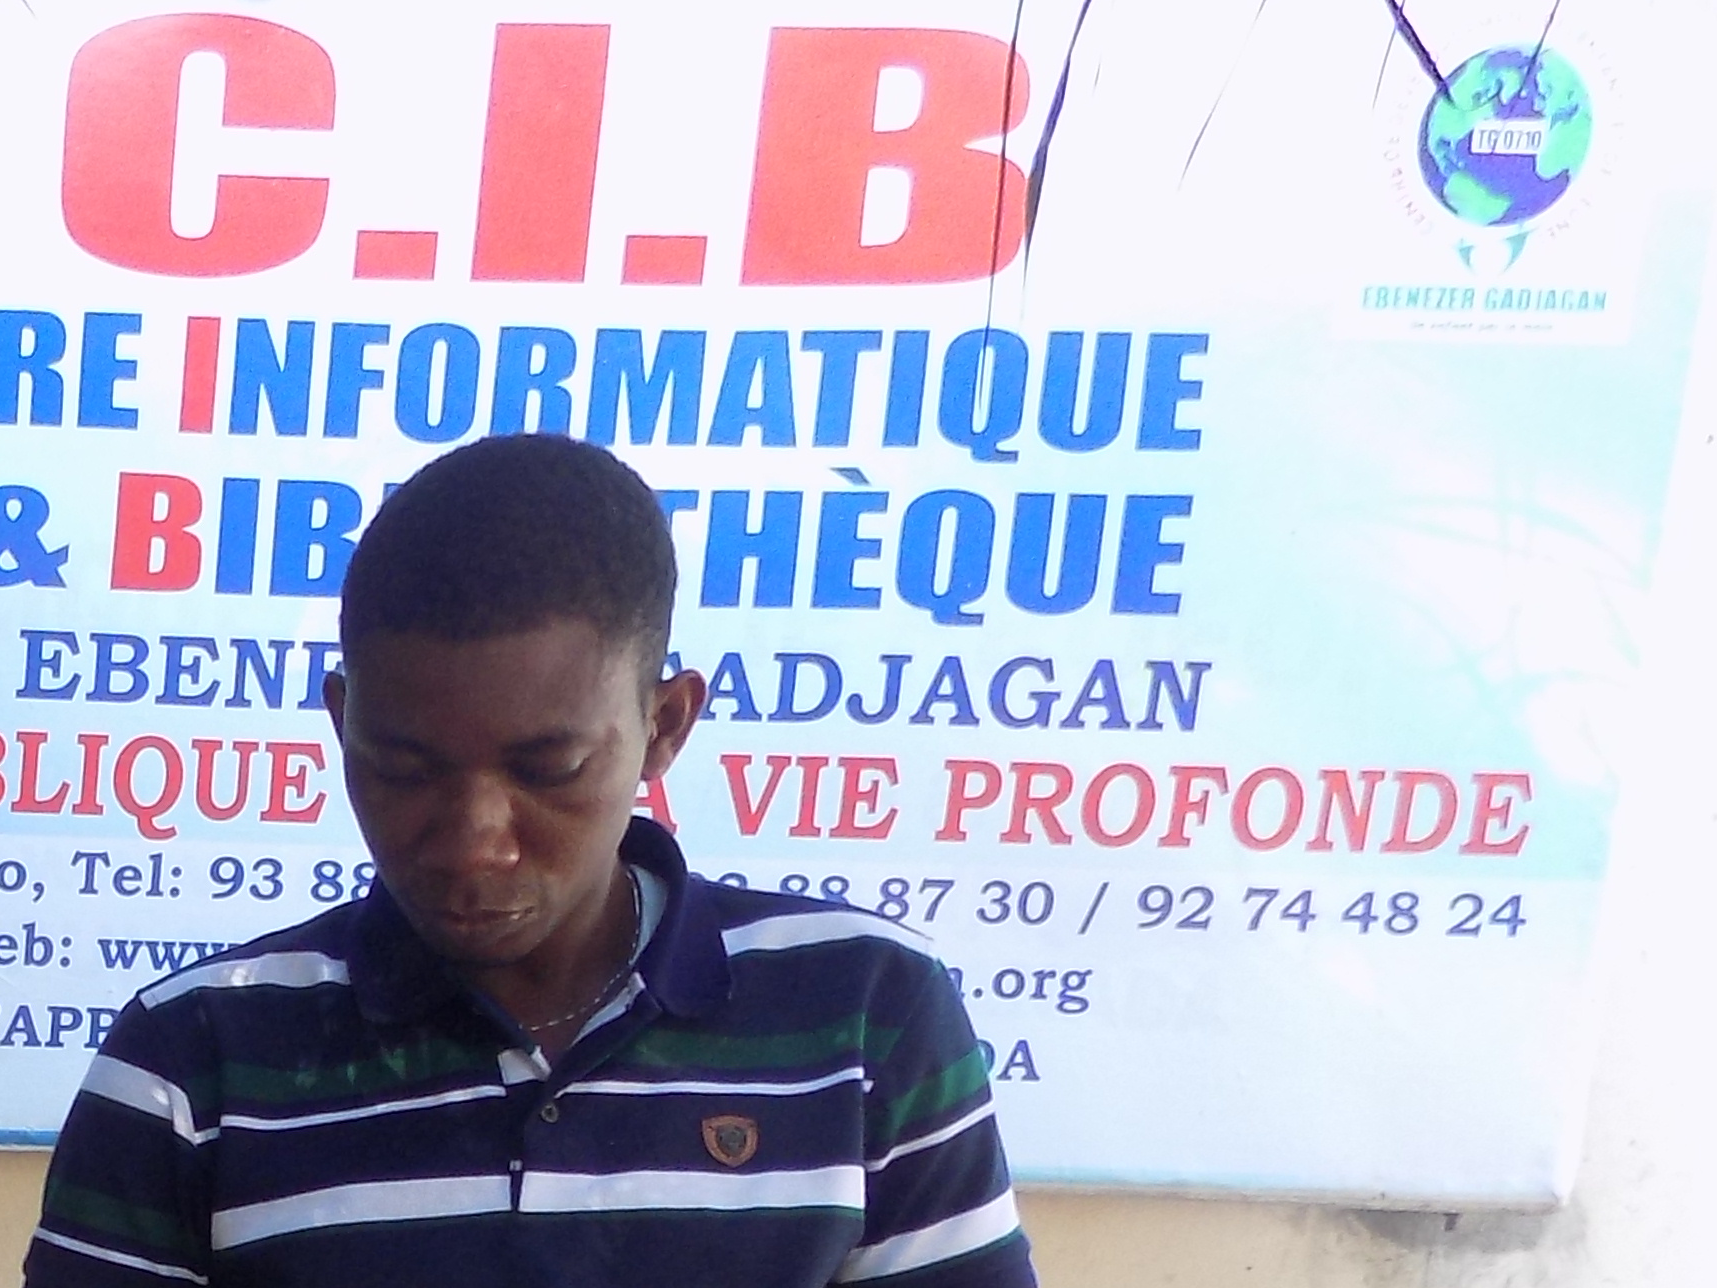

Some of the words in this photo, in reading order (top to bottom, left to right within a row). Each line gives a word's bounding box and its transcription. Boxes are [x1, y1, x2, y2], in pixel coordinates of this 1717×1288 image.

[61, 12, 1030, 286] C.I.B
[1362, 285, 1476, 311] EBENEZER
[179, 316, 1210, 464] INFORMATIQUE
[662, 650, 1212, 731] ADJAGAN
[718, 753, 900, 842] VIE
[933, 757, 1534, 858] PROFONDE
[70, 850, 183, 898] Tel:
[208, 856, 285, 901] 93
[875, 876, 956, 923] 87
[975, 879, 1055, 928] 30
[1078, 879, 1110, 933] /
[1137, 884, 1213, 932] 92
[1242, 886, 1318, 934] 74
[1340, 888, 1421, 936] 48
[1447, 892, 1528, 939] 24
